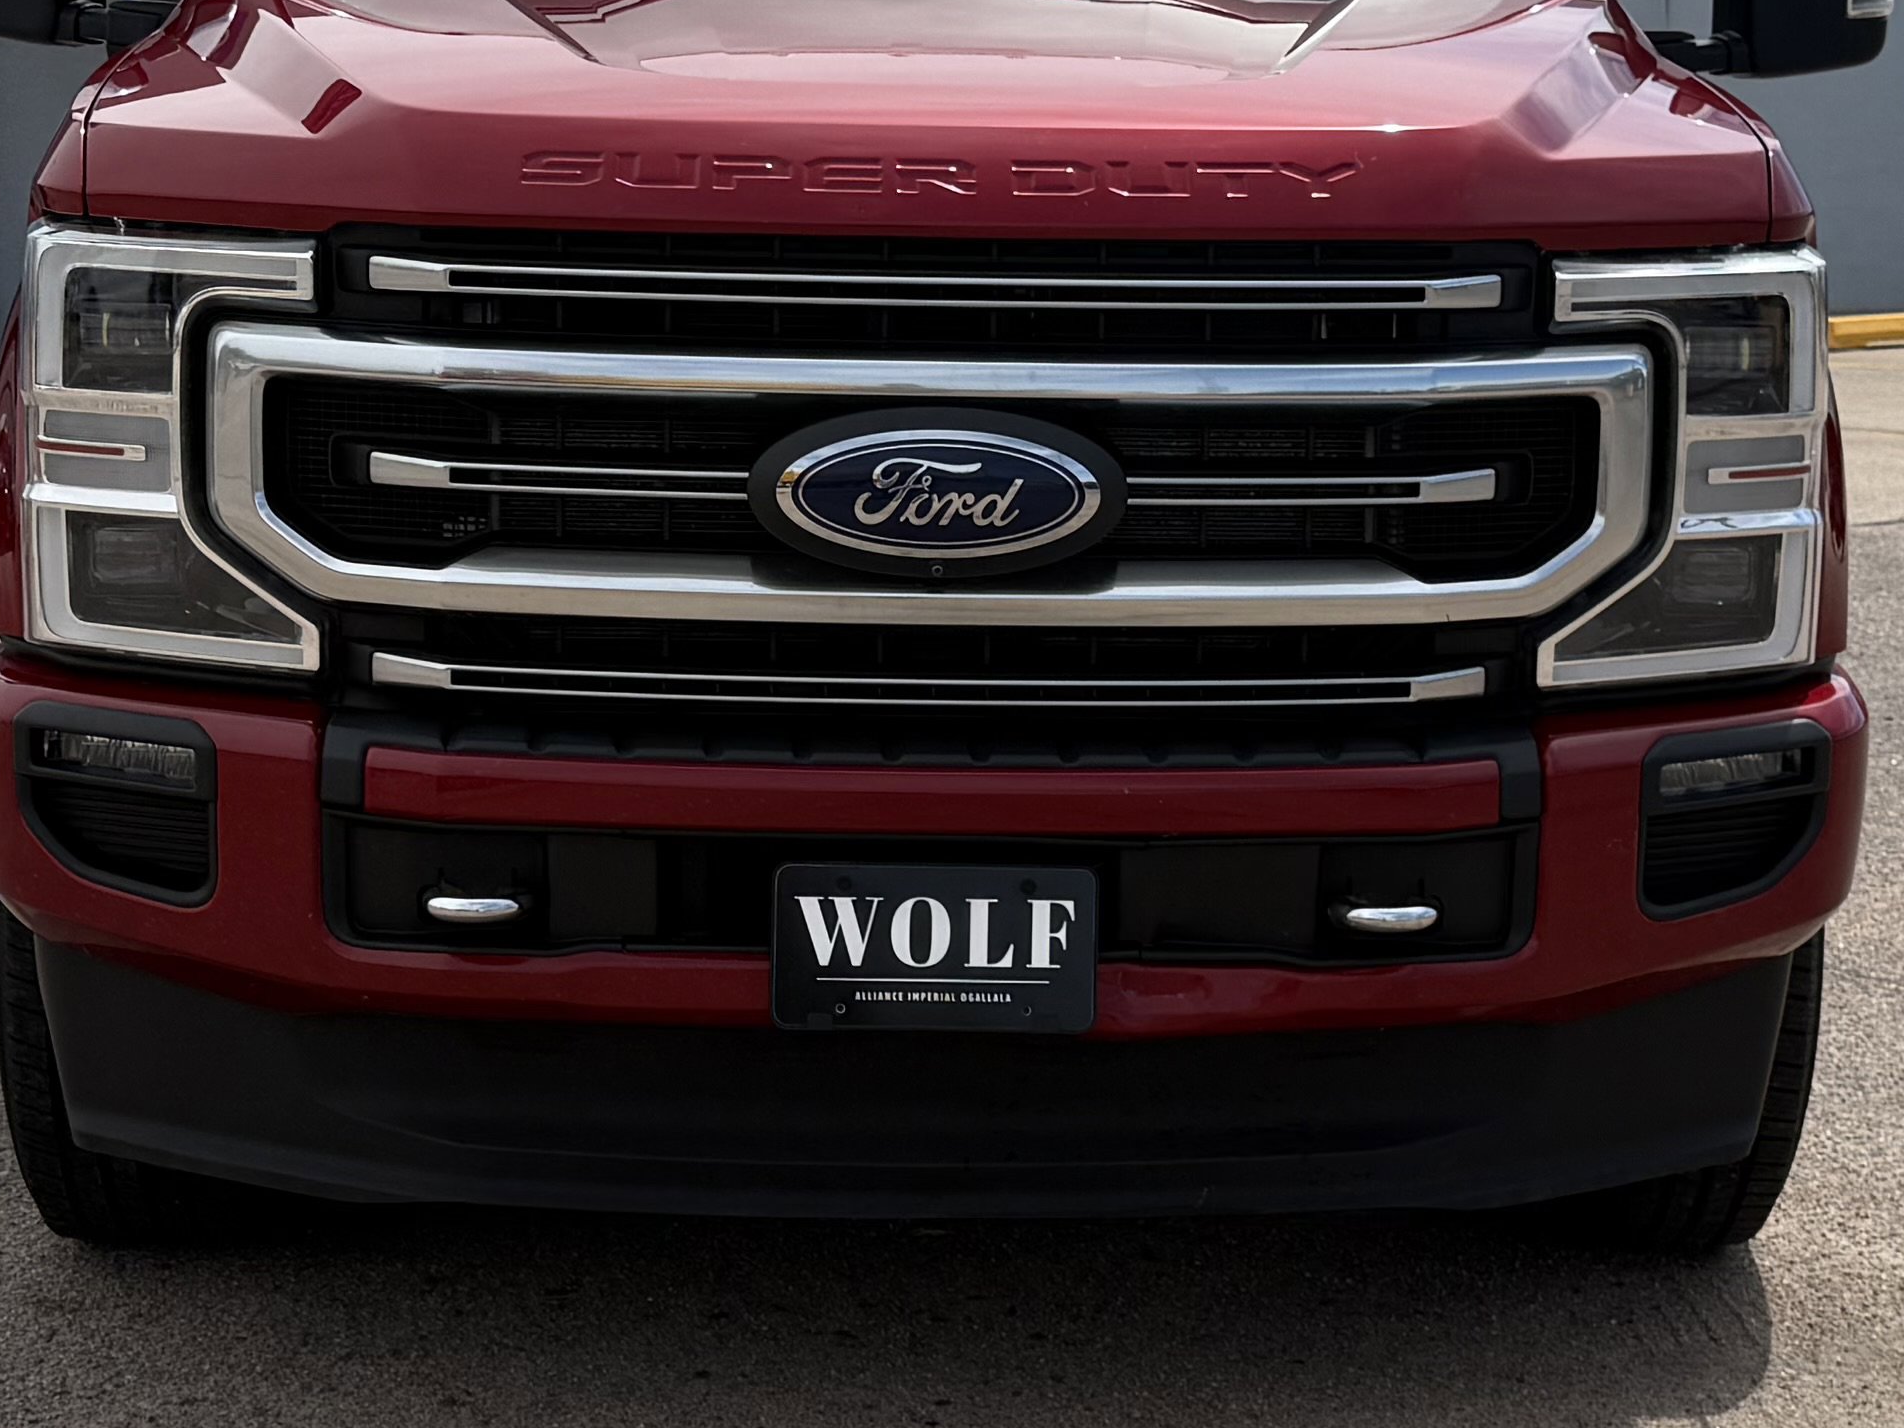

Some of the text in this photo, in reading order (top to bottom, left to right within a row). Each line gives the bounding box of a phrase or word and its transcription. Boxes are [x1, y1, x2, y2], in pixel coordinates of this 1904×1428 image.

[521, 149, 1359, 199] SUPER DUTY
[854, 457, 1024, 526] Ford
[794, 895, 1076, 969] WOLF
[854, 991, 1012, 1003] ALLIANCE IMPERIAL OGALLALA
